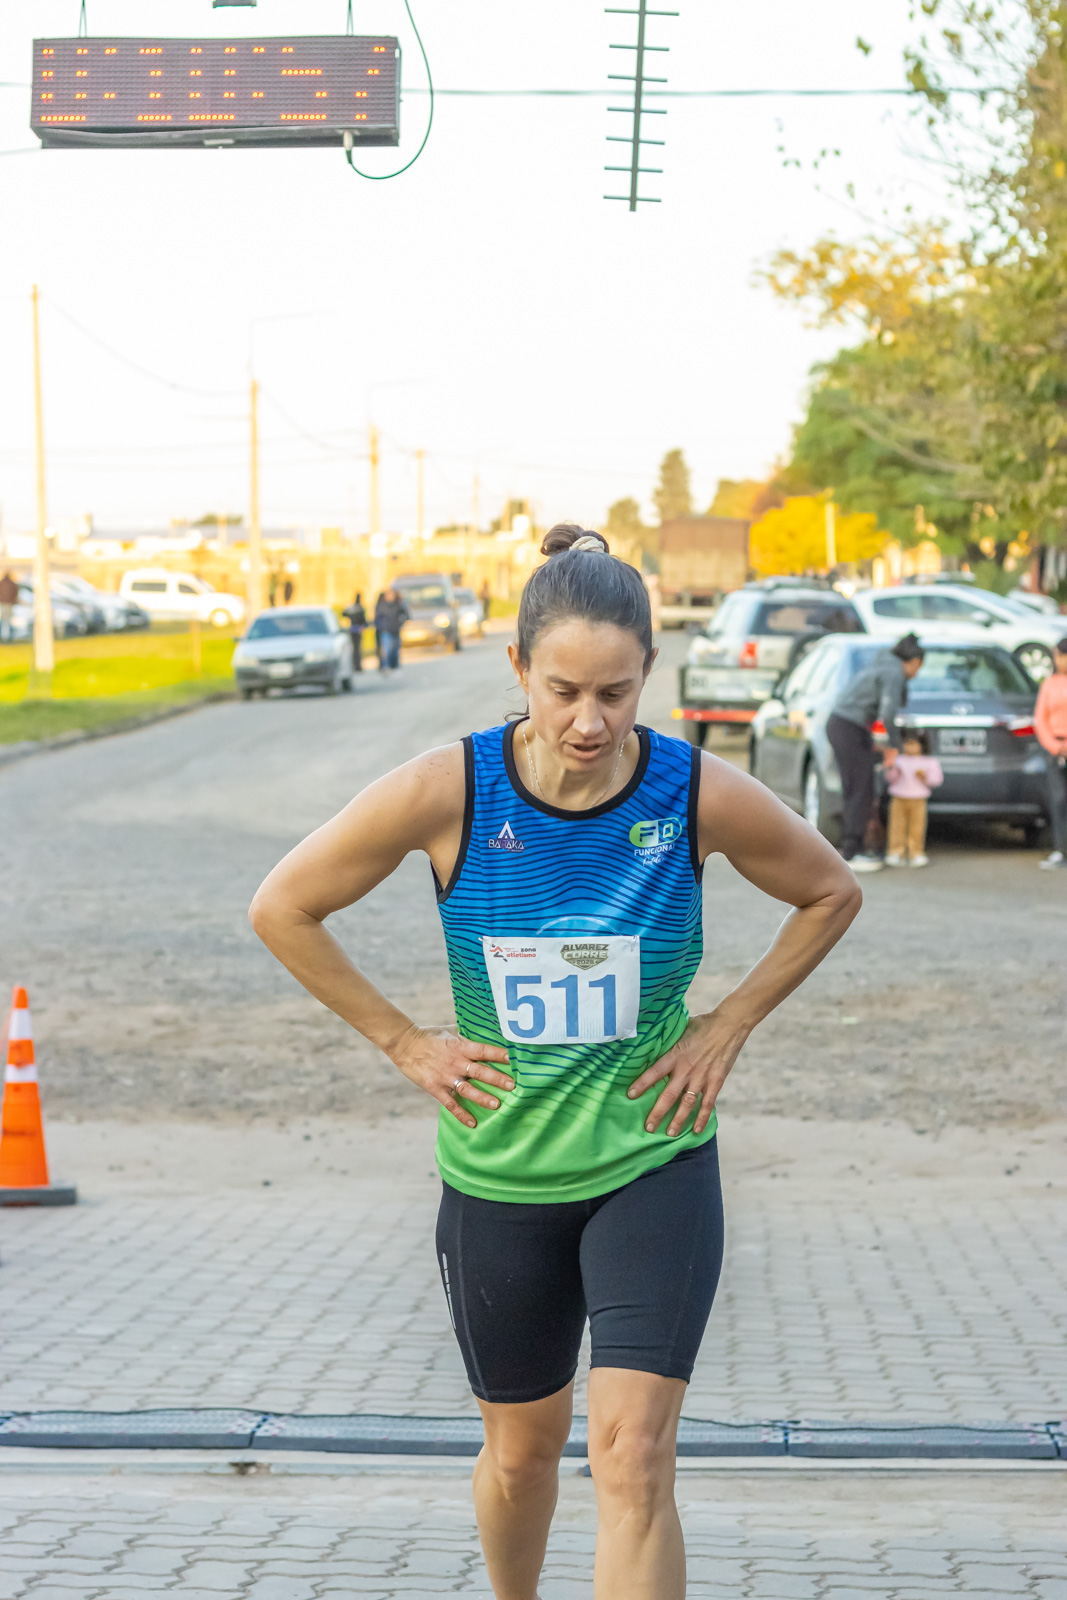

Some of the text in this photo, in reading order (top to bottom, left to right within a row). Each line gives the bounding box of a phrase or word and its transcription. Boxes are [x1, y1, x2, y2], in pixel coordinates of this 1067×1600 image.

[561, 943, 610, 952] ALVAREZ
[563, 950, 608, 959] CORRE
[505, 974, 617, 1039] 511
